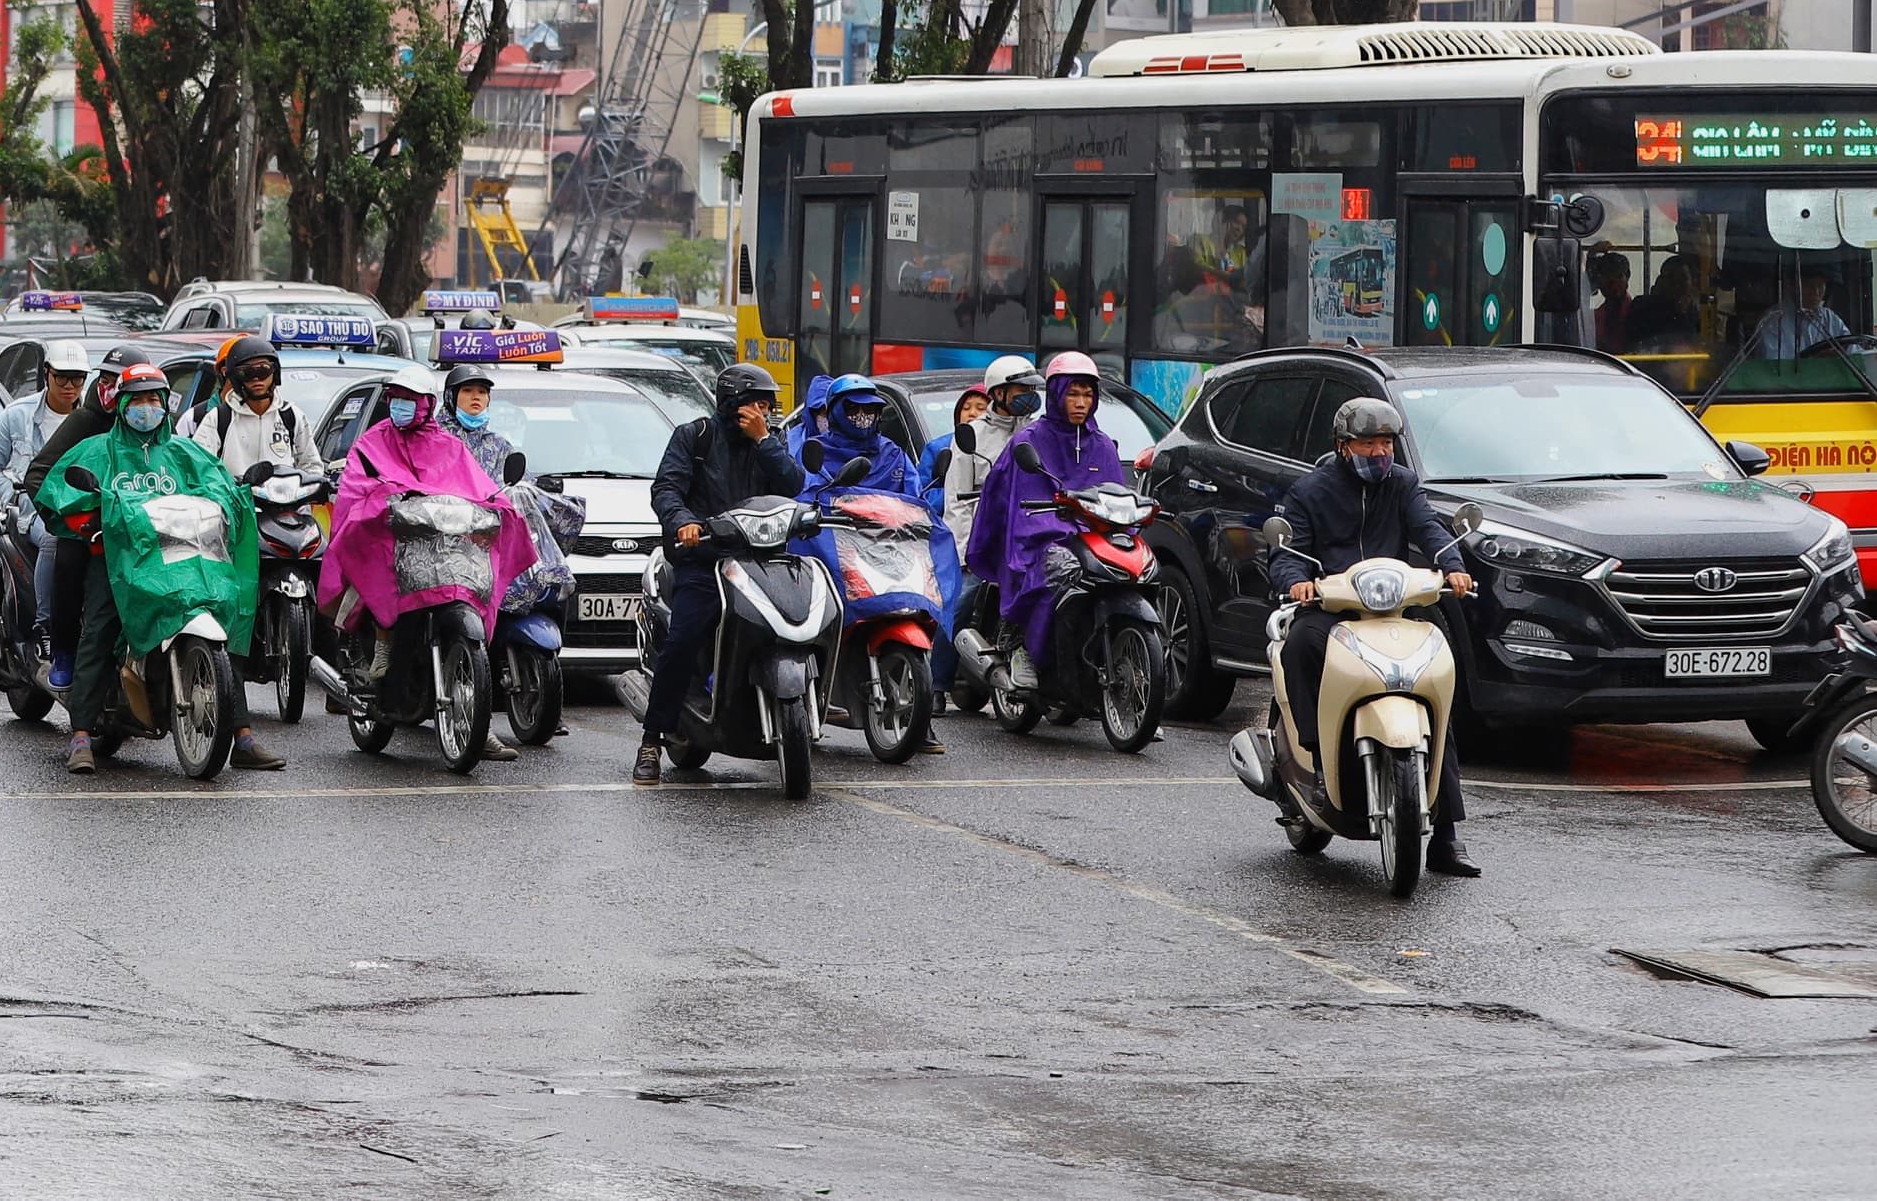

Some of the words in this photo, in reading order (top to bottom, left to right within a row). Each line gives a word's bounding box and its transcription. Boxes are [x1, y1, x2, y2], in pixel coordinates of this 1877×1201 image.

[300, 320, 324, 335] SAO
[495, 336, 516, 347] Giá
[498, 346, 528, 360] Luôn
[529, 341, 547, 353] Tốt
[1816, 440, 1842, 467] HÀ
[111, 465, 178, 495] Grab
[616, 540, 635, 549] KIA
[1668, 651, 1768, 675] 30E-672.28
